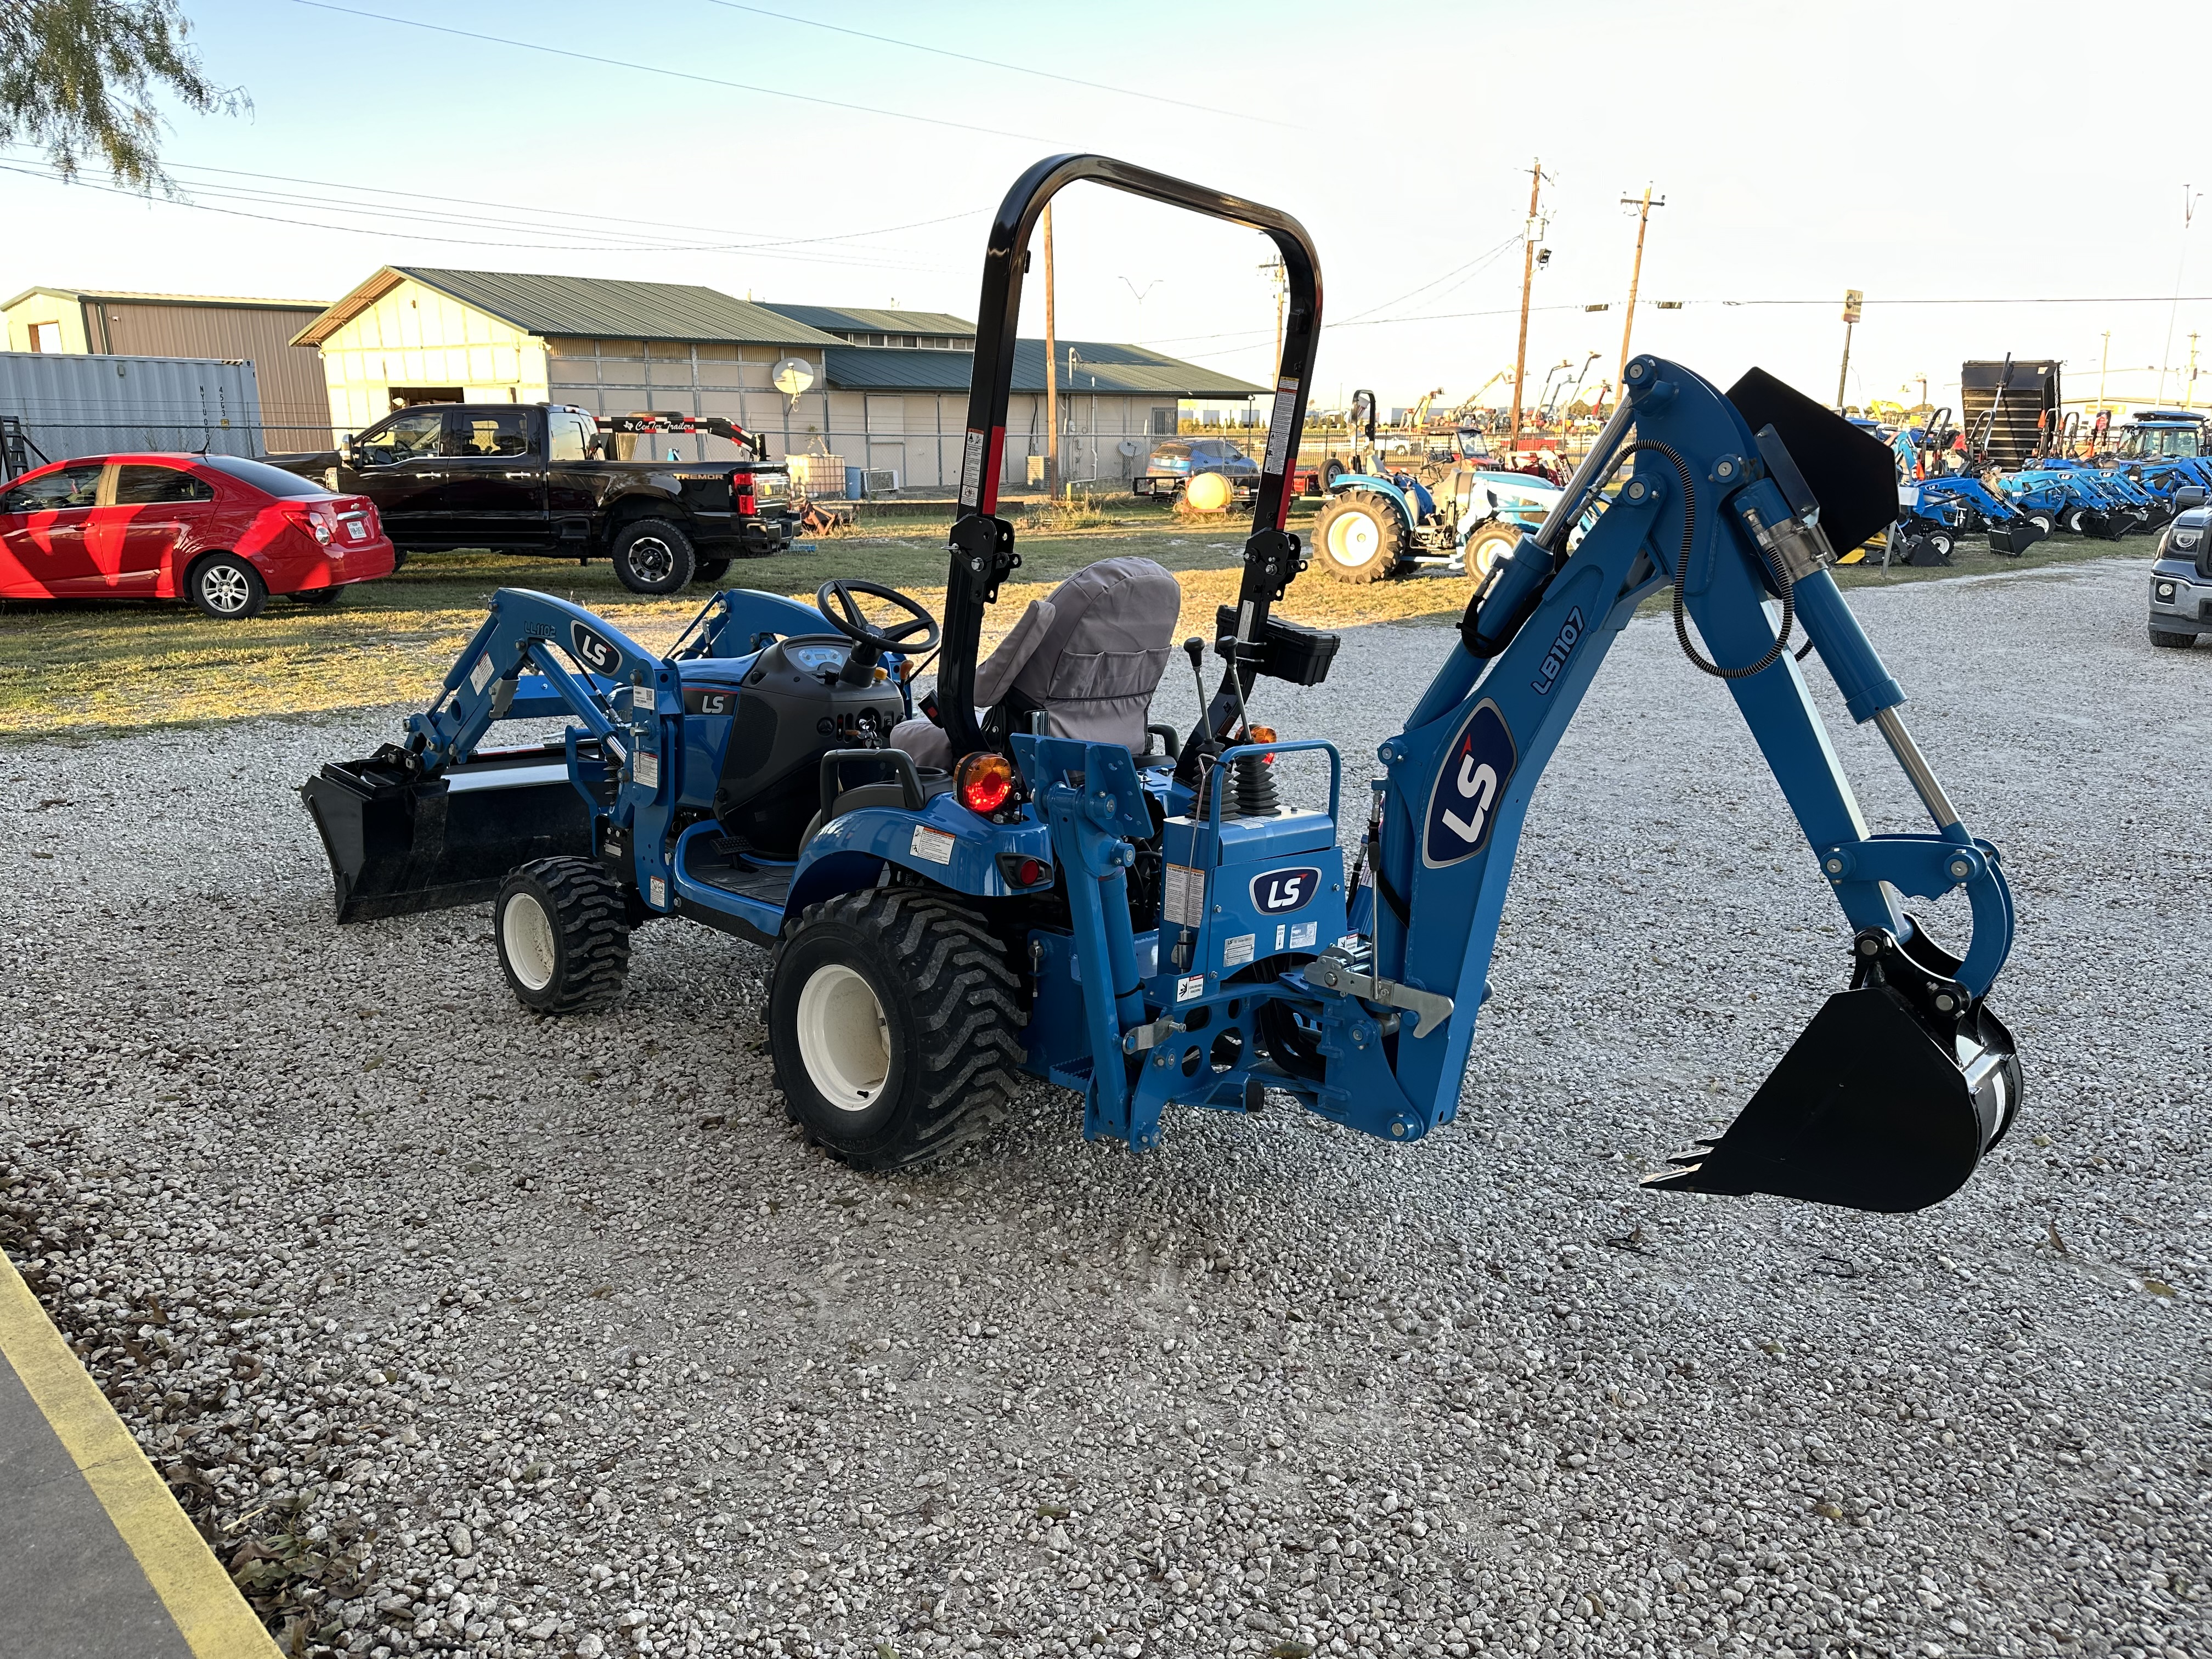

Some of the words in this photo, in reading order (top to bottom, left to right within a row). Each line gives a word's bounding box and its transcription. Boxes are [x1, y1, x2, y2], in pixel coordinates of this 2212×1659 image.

[635, 420, 662, 431] CenTex
[664, 421, 695, 430] Trailers
[524, 620, 556, 638] LL1102
[582, 635, 608, 666] LS
[1531, 606, 1585, 695] LB1107
[702, 695, 725, 713] LS
[1442, 753, 1497, 843] LS
[1268, 877, 1302, 909] LS
